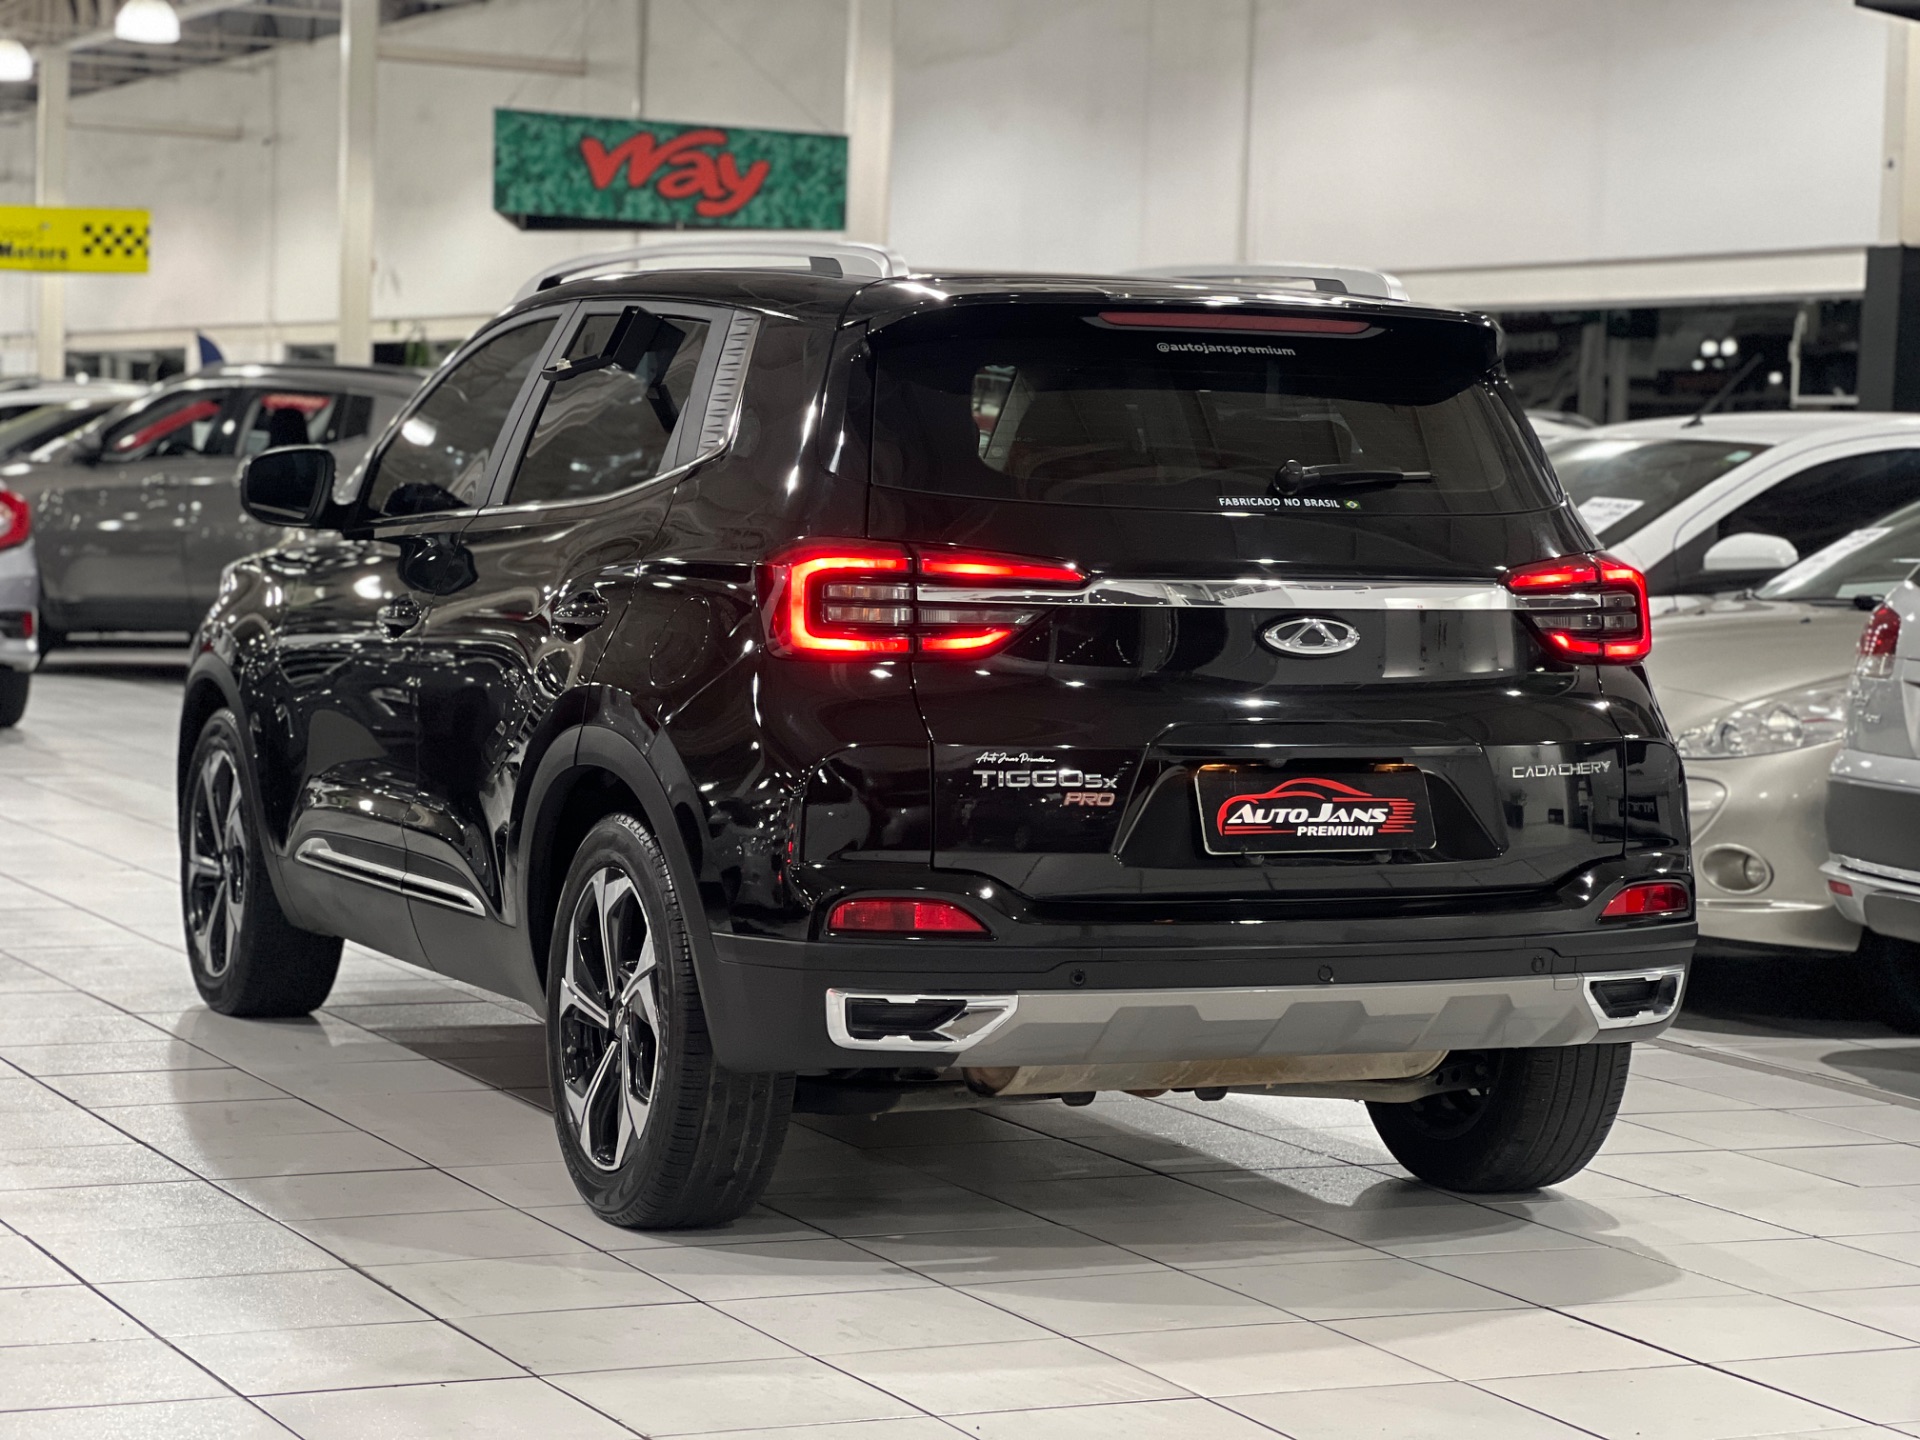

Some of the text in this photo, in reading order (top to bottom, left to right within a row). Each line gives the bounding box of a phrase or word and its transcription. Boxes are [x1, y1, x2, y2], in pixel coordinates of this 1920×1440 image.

[580, 129, 770, 218] Way
[1156, 342, 1296, 356] @autojanspremium
[1218, 497, 1341, 508] FABRICADO NO BRASIL
[1063, 792, 1116, 806] PRO
[1296, 825, 1374, 837] PREMIUM
